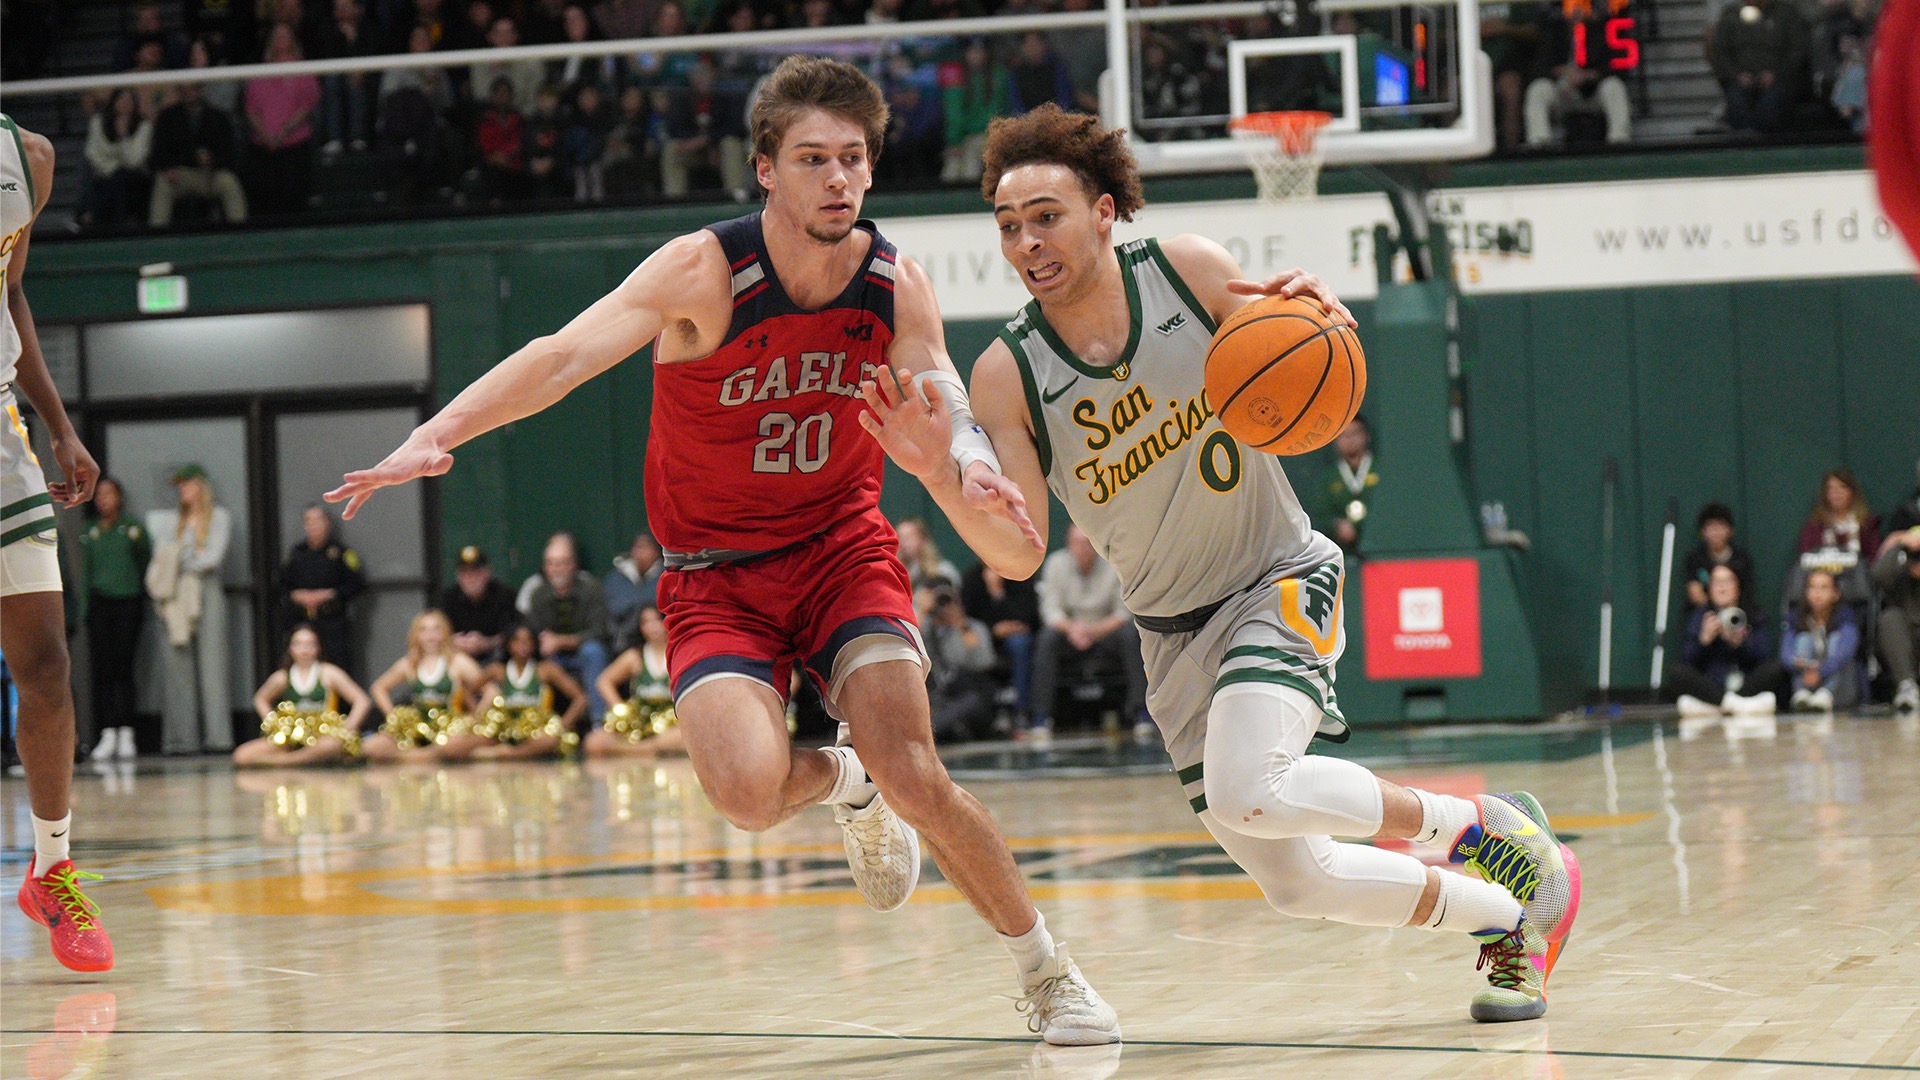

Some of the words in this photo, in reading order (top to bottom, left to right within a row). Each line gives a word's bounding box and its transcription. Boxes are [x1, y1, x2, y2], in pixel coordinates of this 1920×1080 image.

[1573, 17, 1640, 71] 15
[1226, 233, 1286, 269] OF
[1593, 207, 1894, 252] www.usfdo
[1156, 310, 1188, 334] WCC
[718, 351, 879, 407] GAELS
[752, 410, 834, 475] 20
[1072, 383, 1154, 451] San
[1074, 385, 1215, 505] Francisc
[1197, 428, 1242, 494] 0
[1393, 633, 1453, 651] TOYOTA
